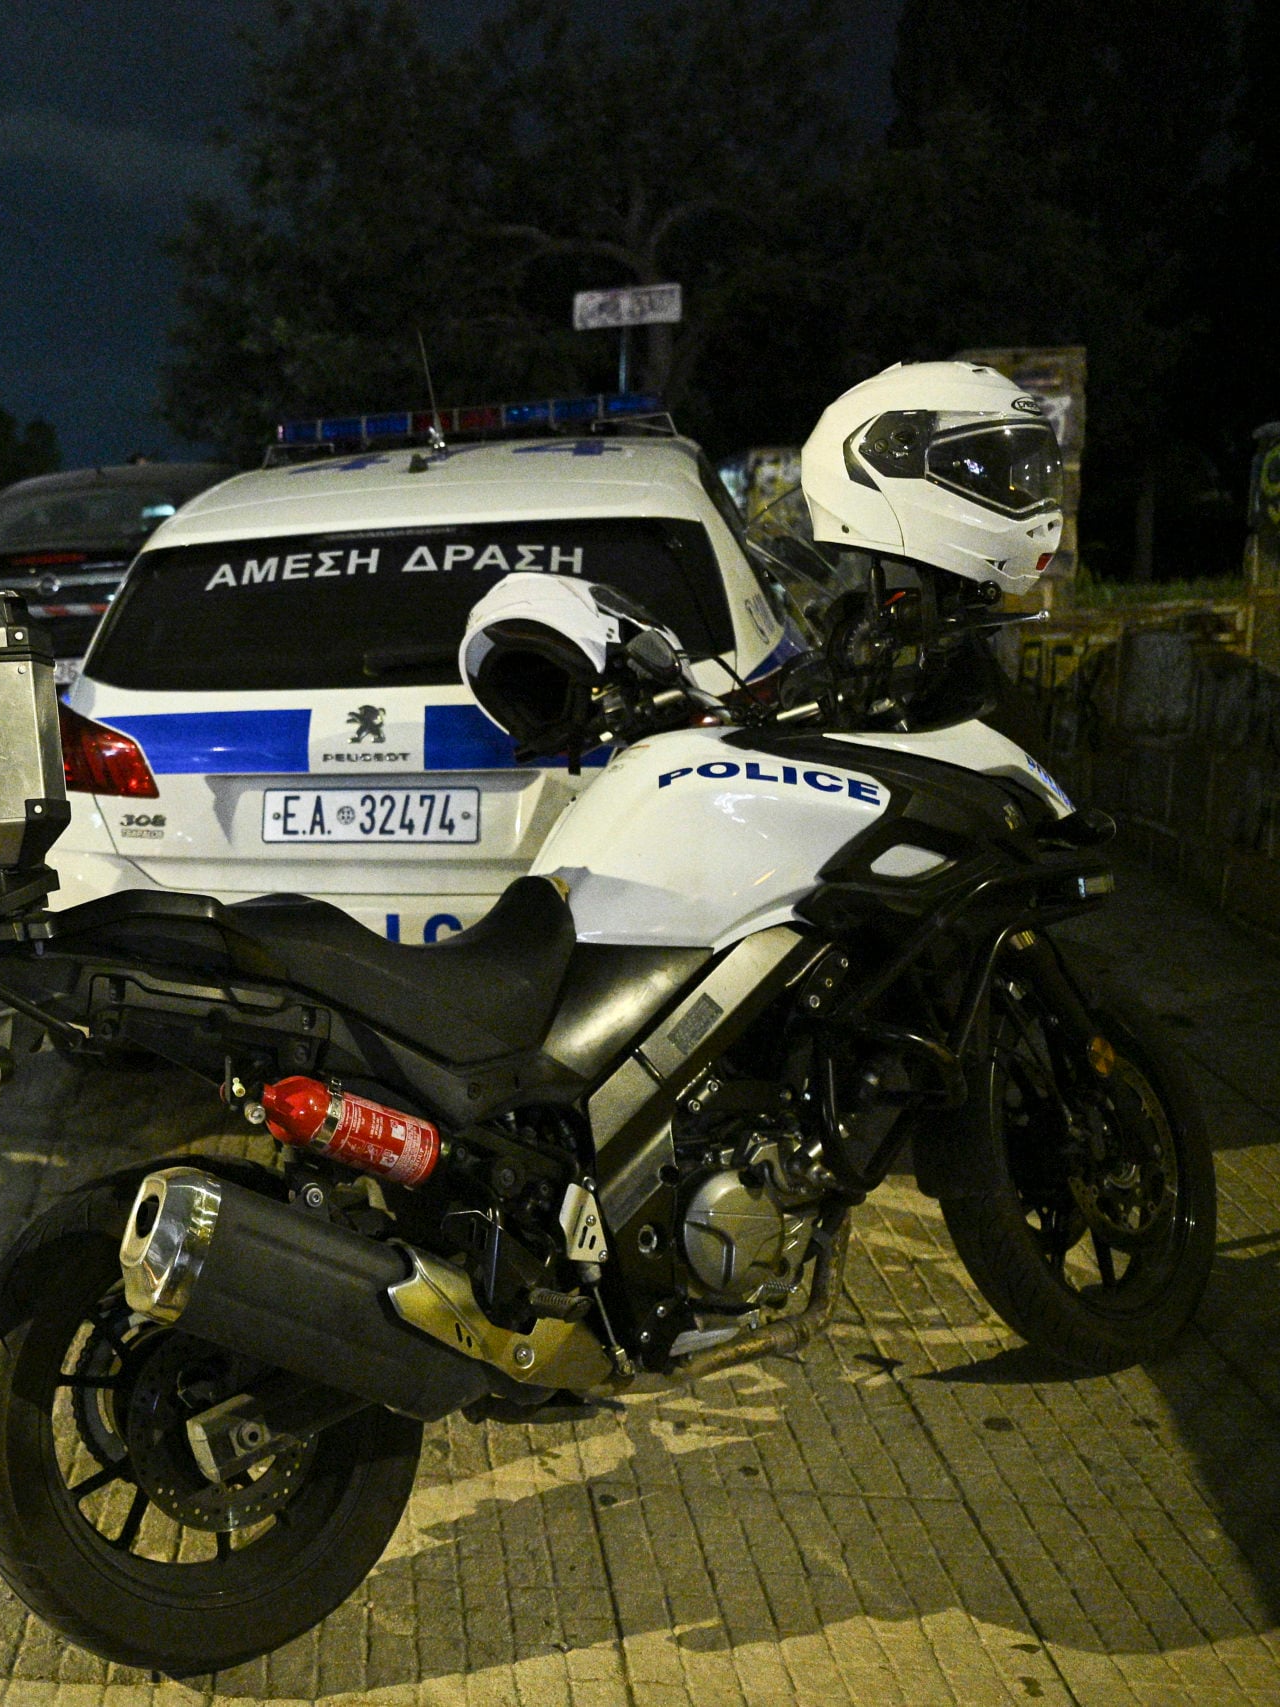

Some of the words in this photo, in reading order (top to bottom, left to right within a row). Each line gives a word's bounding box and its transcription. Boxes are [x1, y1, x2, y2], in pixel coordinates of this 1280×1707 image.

[205, 548, 380, 591] ΑΜΕΣΗ
[401, 544, 583, 574] ΔΡΑΣΗ
[322, 752, 410, 762] PEUGEOT
[658, 761, 881, 806] POLICE
[120, 814, 166, 827] 308
[359, 794, 455, 836] 32474
